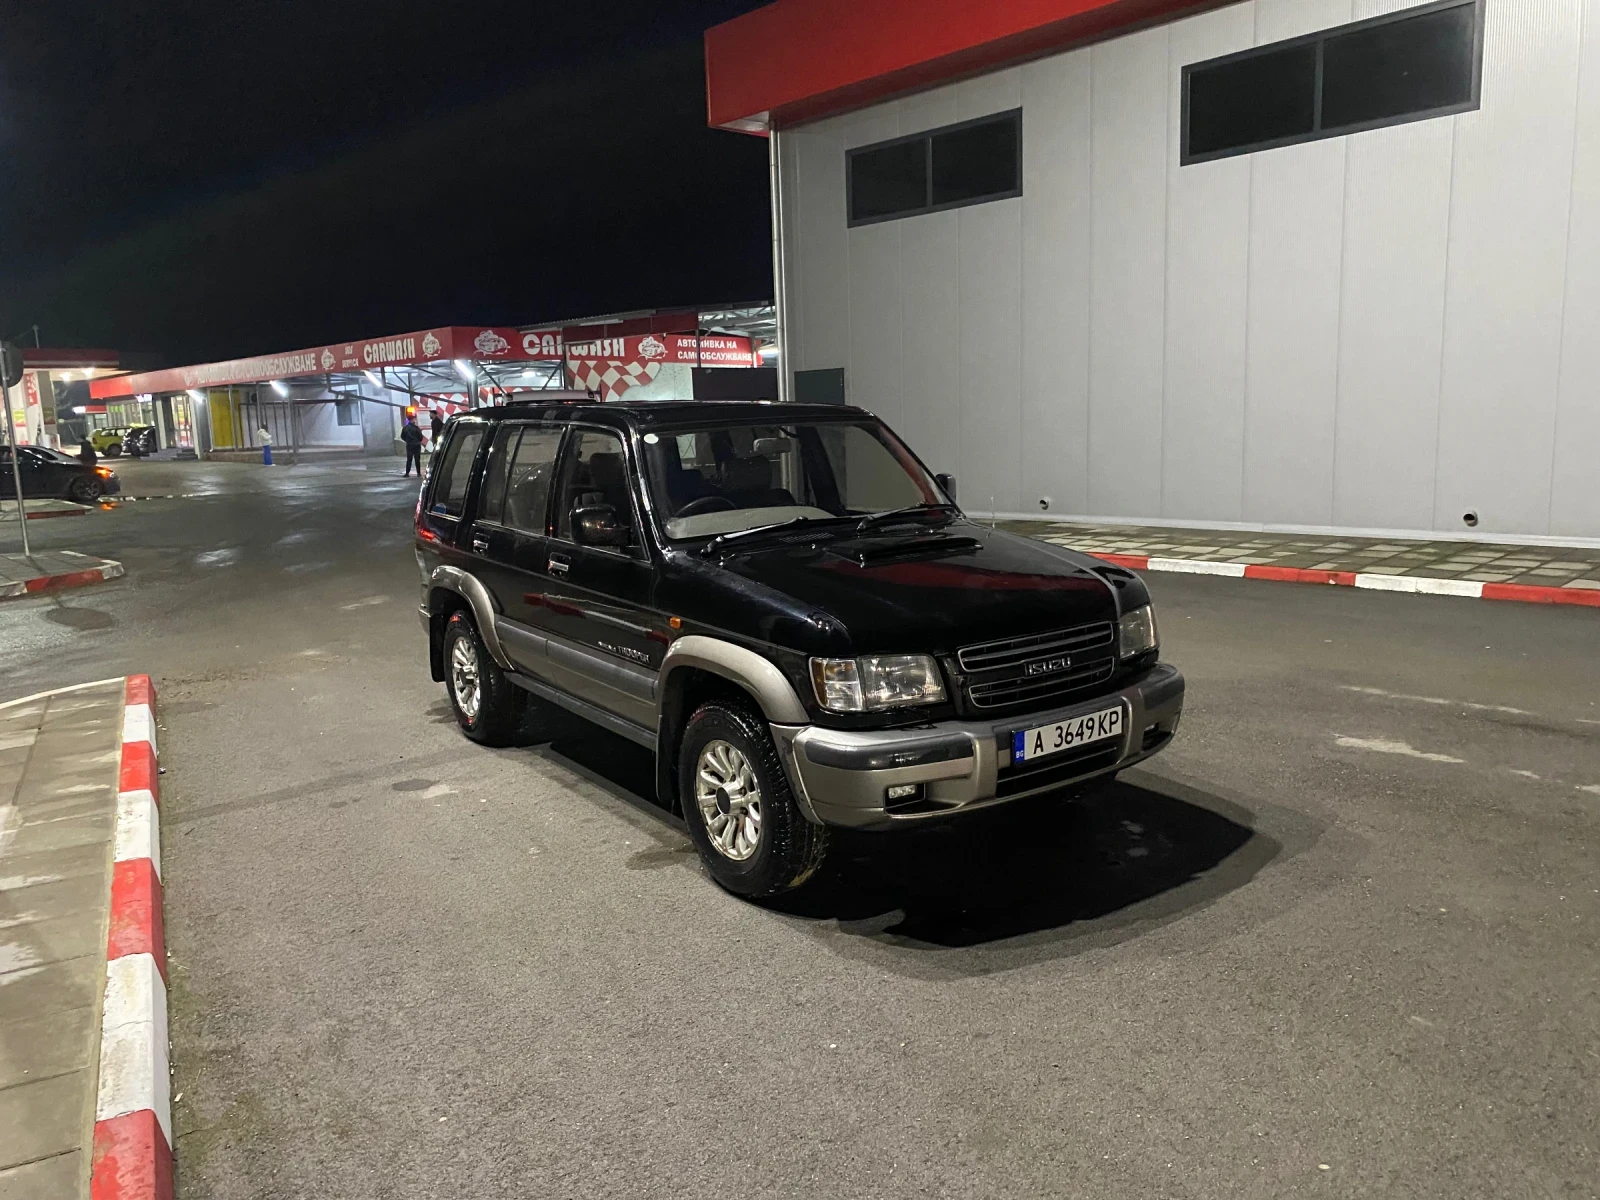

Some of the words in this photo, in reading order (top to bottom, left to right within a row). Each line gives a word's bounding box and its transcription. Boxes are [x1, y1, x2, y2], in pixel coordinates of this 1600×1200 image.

[363, 337, 416, 364] CARWASH
[726, 340, 737, 349] НА
[1024, 657, 1071, 676] ISUZU
[1033, 730, 1044, 755] A
[1053, 711, 1119, 748] 3649KP
[1016, 750, 1024, 759] BG
